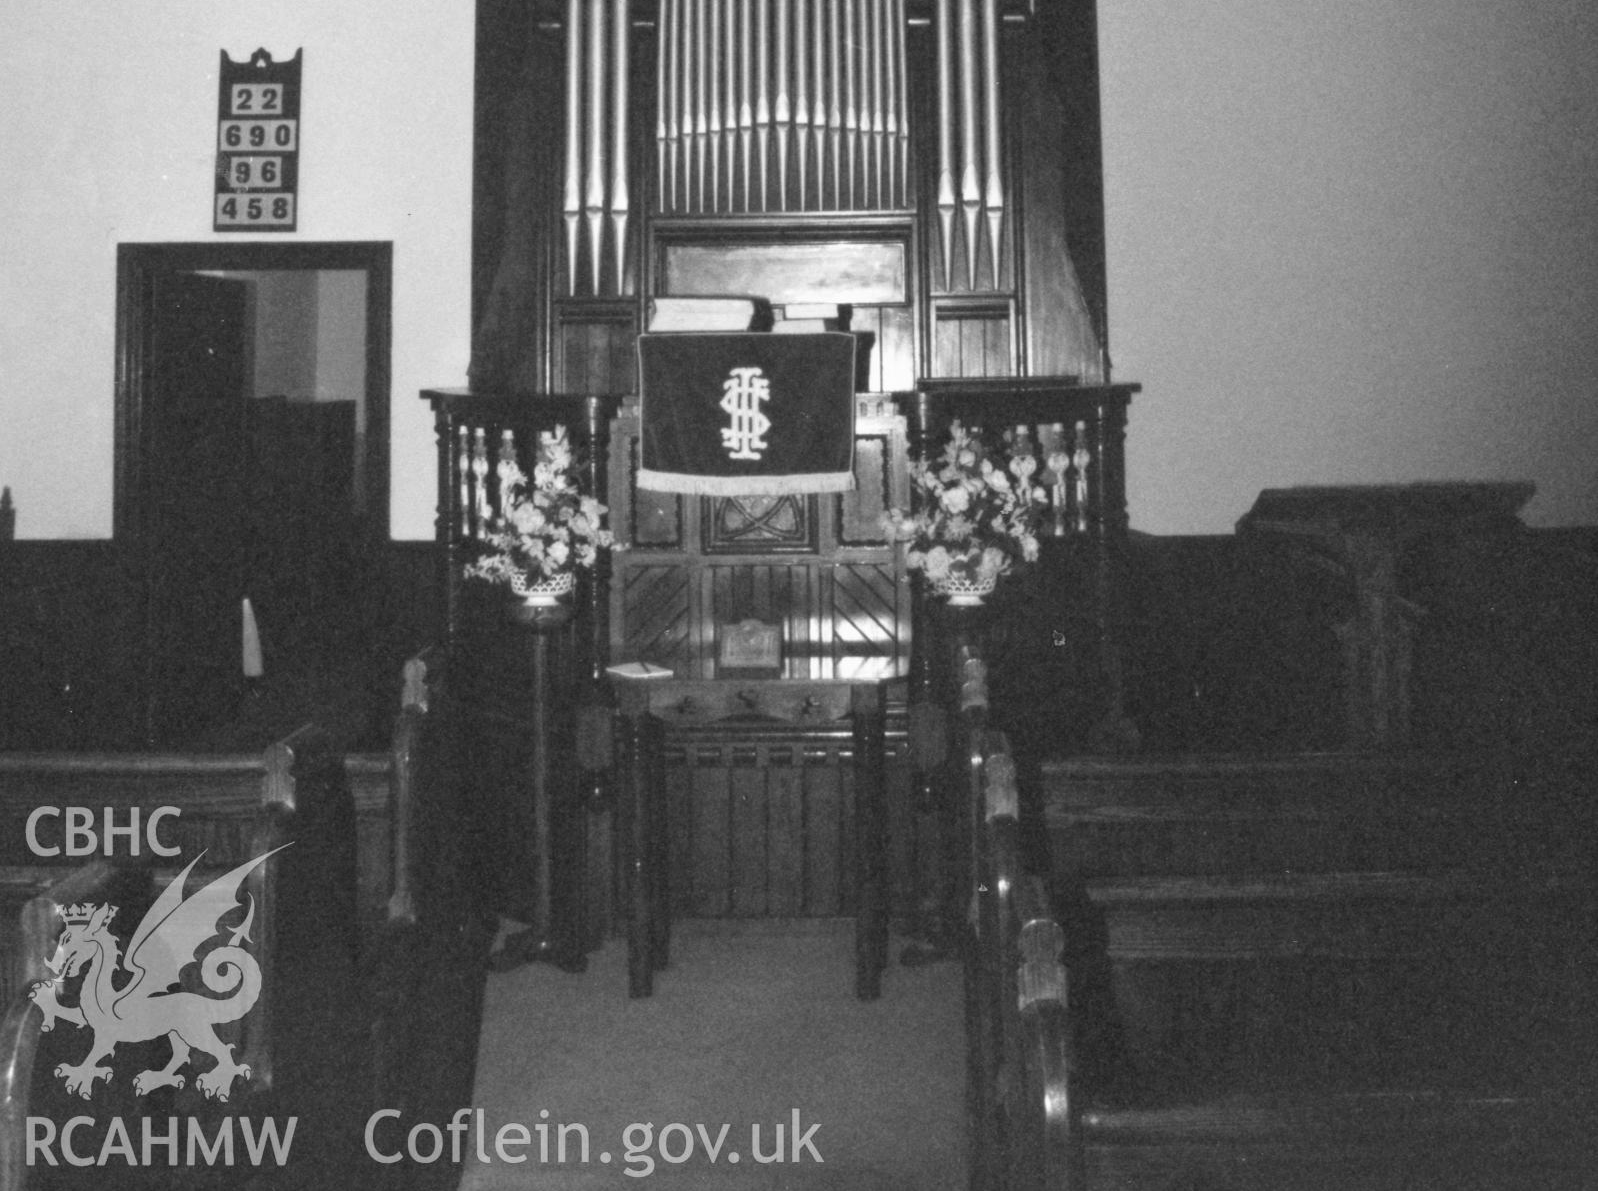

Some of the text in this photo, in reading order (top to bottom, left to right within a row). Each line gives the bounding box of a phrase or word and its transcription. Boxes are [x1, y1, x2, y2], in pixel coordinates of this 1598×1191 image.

[237, 88, 278, 110] 22
[225, 124, 291, 147] 690
[235, 161, 277, 184] 96
[221, 197, 289, 220] 458
